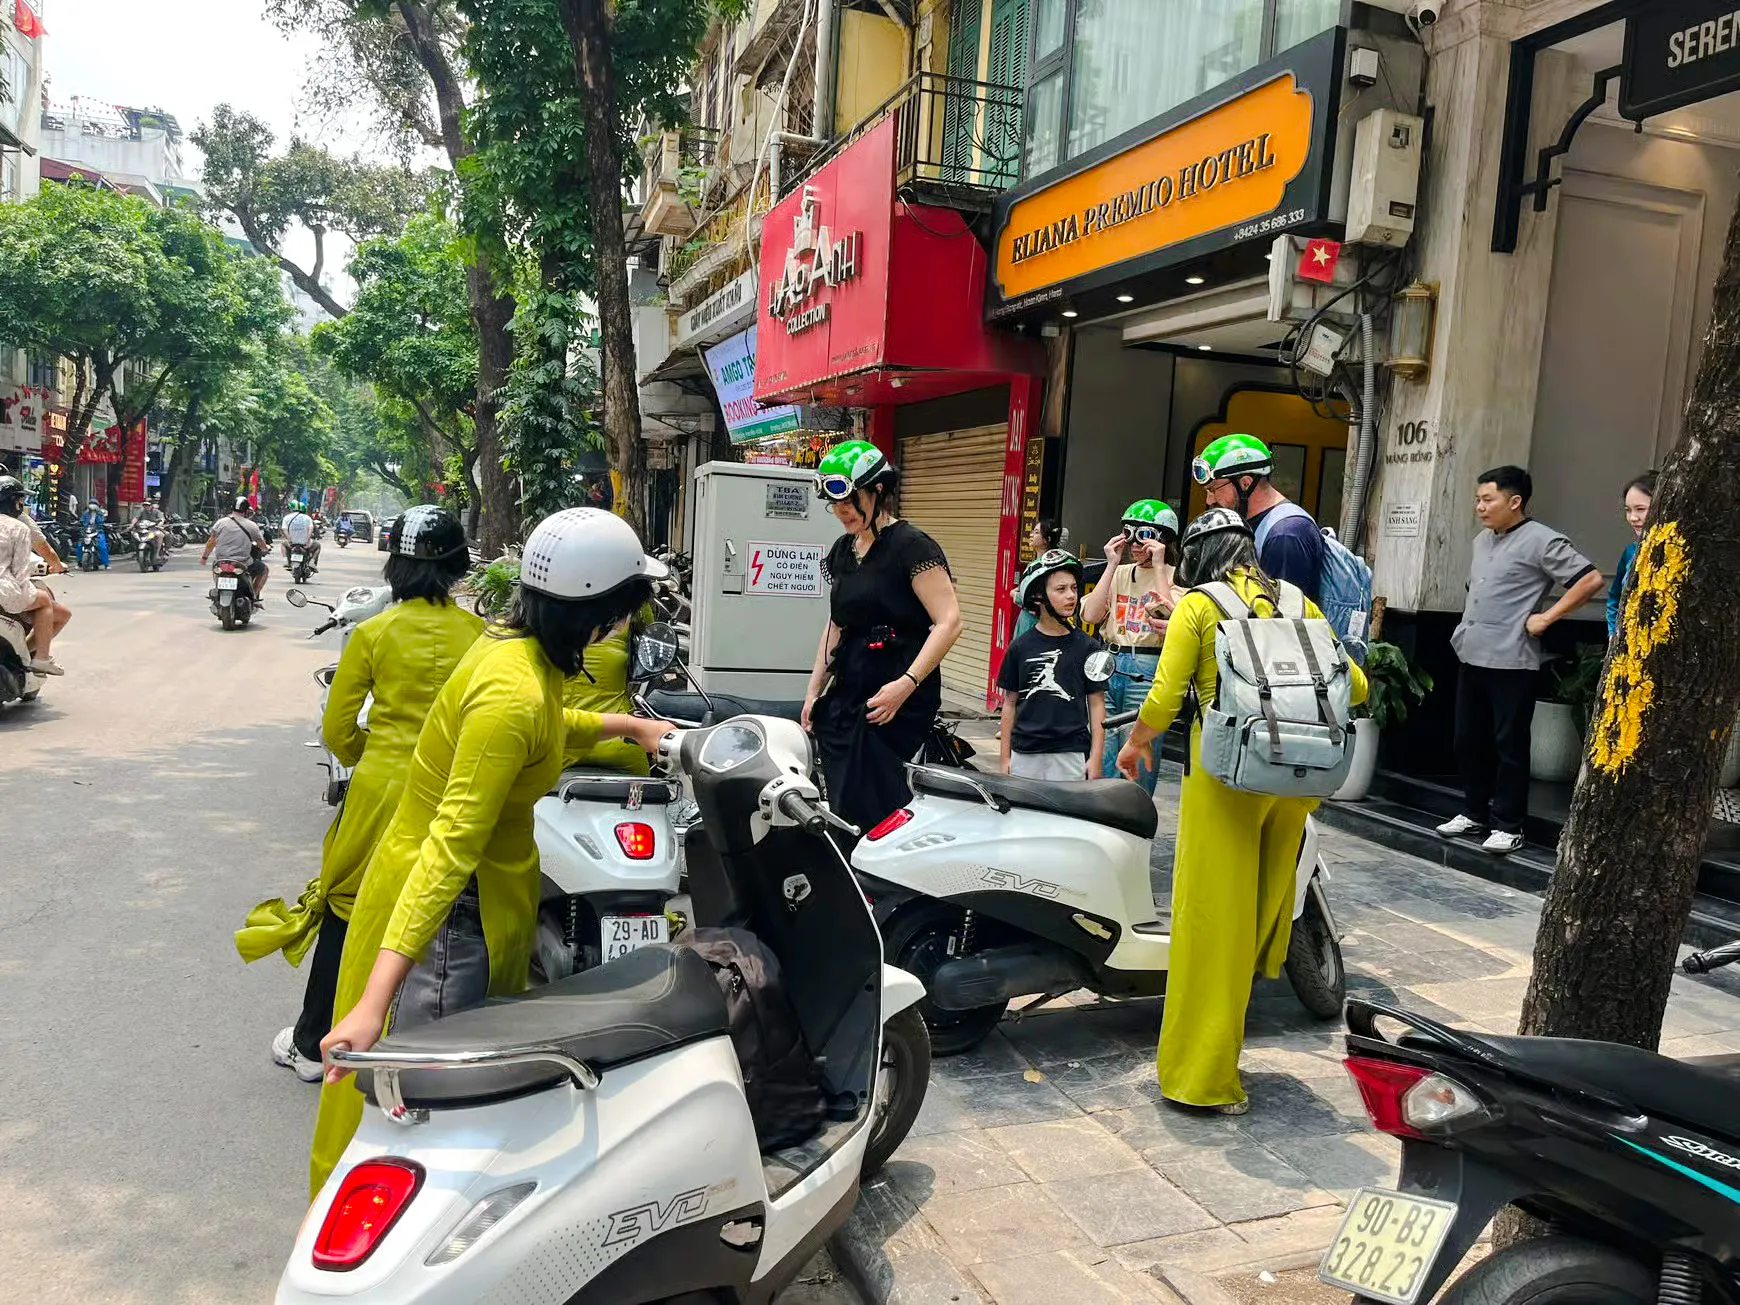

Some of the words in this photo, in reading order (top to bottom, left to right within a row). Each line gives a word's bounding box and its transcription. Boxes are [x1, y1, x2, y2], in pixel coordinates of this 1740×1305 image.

[1011, 214, 1081, 264] ELIANA
[1082, 175, 1174, 237] PREMIO
[1176, 133, 1276, 201] HOTEL
[1233, 222, 1259, 241] +8424
[1287, 208, 1306, 226] 333
[786, 304, 831, 335] COLLECTION
[720, 359, 744, 386] AMGO
[722, 395, 758, 424] BOOKING
[1397, 420, 1428, 446] 106
[776, 486, 800, 494] TBA
[767, 547, 796, 560] DỪNG
[800, 551, 819, 563] LẠI!
[776, 561, 789, 569] CÓ
[767, 582, 789, 590] CHẾT
[770, 572, 793, 580] NGUY
[980, 867, 1062, 899] EVO
[612, 919, 659, 941] 29-AD
[601, 1183, 710, 1247] EVO
[1356, 1195, 1438, 1249] 90-B3
[1327, 1236, 1425, 1297] 328.23
